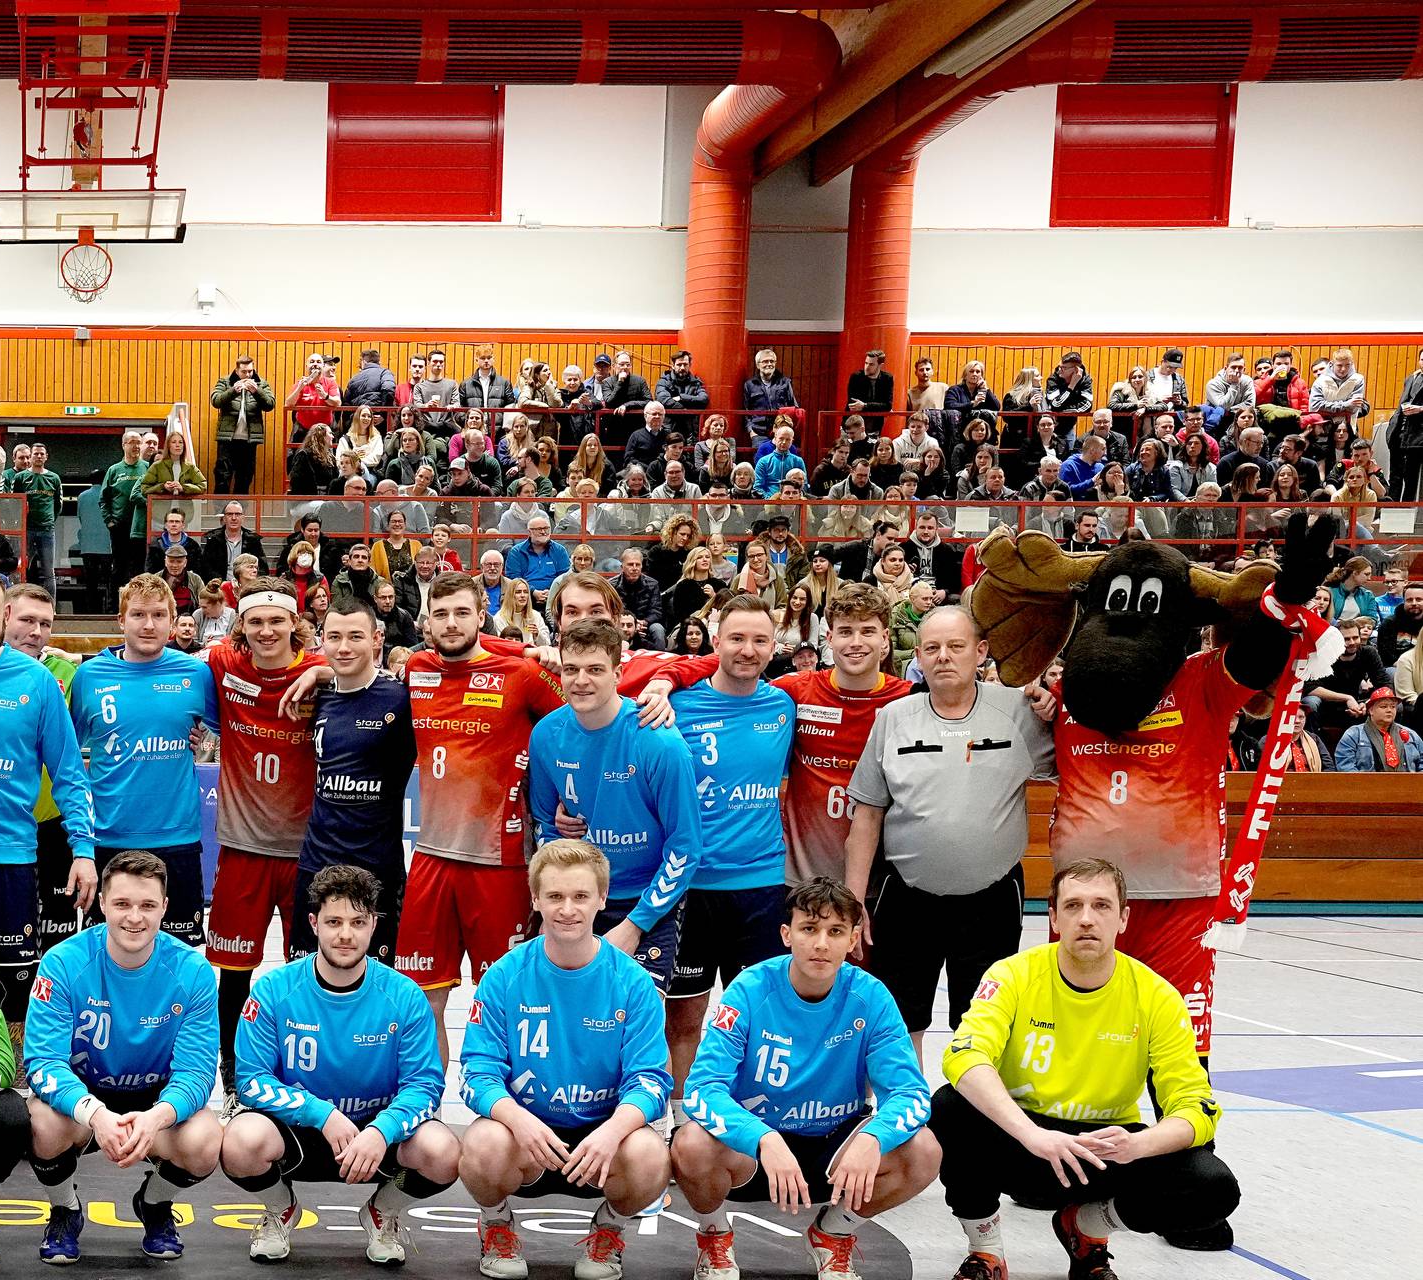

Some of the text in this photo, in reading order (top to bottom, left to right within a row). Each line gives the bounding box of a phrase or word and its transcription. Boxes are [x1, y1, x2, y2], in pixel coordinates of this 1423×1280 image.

[95, 684, 121, 695] hummel
[539, 671, 568, 703] BARME
[100, 694, 118, 724] 6
[225, 692, 256, 707] Allbau
[228, 719, 313, 745] westenergie
[411, 716, 491, 735] estenergie
[692, 720, 724, 731] hummel
[797, 724, 835, 738] Allbau
[133, 737, 186, 753] Allbau
[700, 732, 719, 766] 3
[1071, 740, 1177, 758] westenergie
[253, 752, 281, 784] 10
[432, 746, 447, 780] 8
[801, 754, 858, 770] westen
[323, 775, 382, 793] Allbau
[565, 773, 579, 804] 4
[1108, 770, 1128, 805] 8
[363, 793, 380, 801] Essen
[585, 829, 648, 845] Allbau
[207, 930, 255, 954] Stauder
[395, 951, 434, 971] auder
[519, 1003, 551, 1014] hummel
[74, 1009, 113, 1051] 20
[286, 1018, 321, 1032] hummel
[516, 1018, 550, 1058] 14
[284, 1033, 318, 1072] 19
[1019, 1030, 1056, 1074] 13
[753, 1043, 792, 1088] 15
[781, 1099, 860, 1122] Allbau
[778, 1122, 798, 1130] Mein
